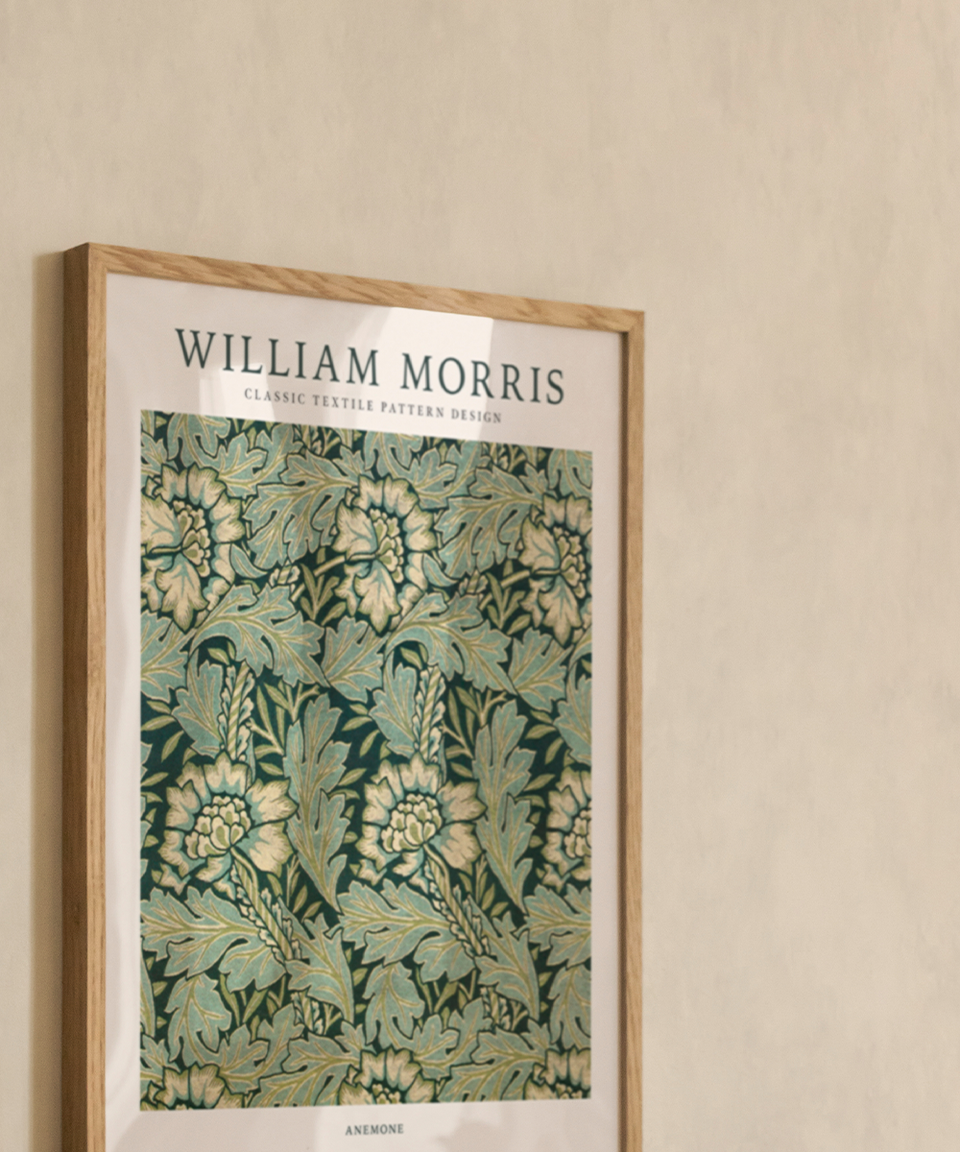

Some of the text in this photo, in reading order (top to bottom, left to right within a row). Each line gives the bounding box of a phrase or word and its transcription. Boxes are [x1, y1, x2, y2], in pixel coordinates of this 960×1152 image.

[174, 328, 565, 406] WILLIAM MORRIS
[244, 388, 502, 424] CLASSIC TEXTILE PATTERN DESIGN
[345, 1123, 404, 1136] ANEMONE
